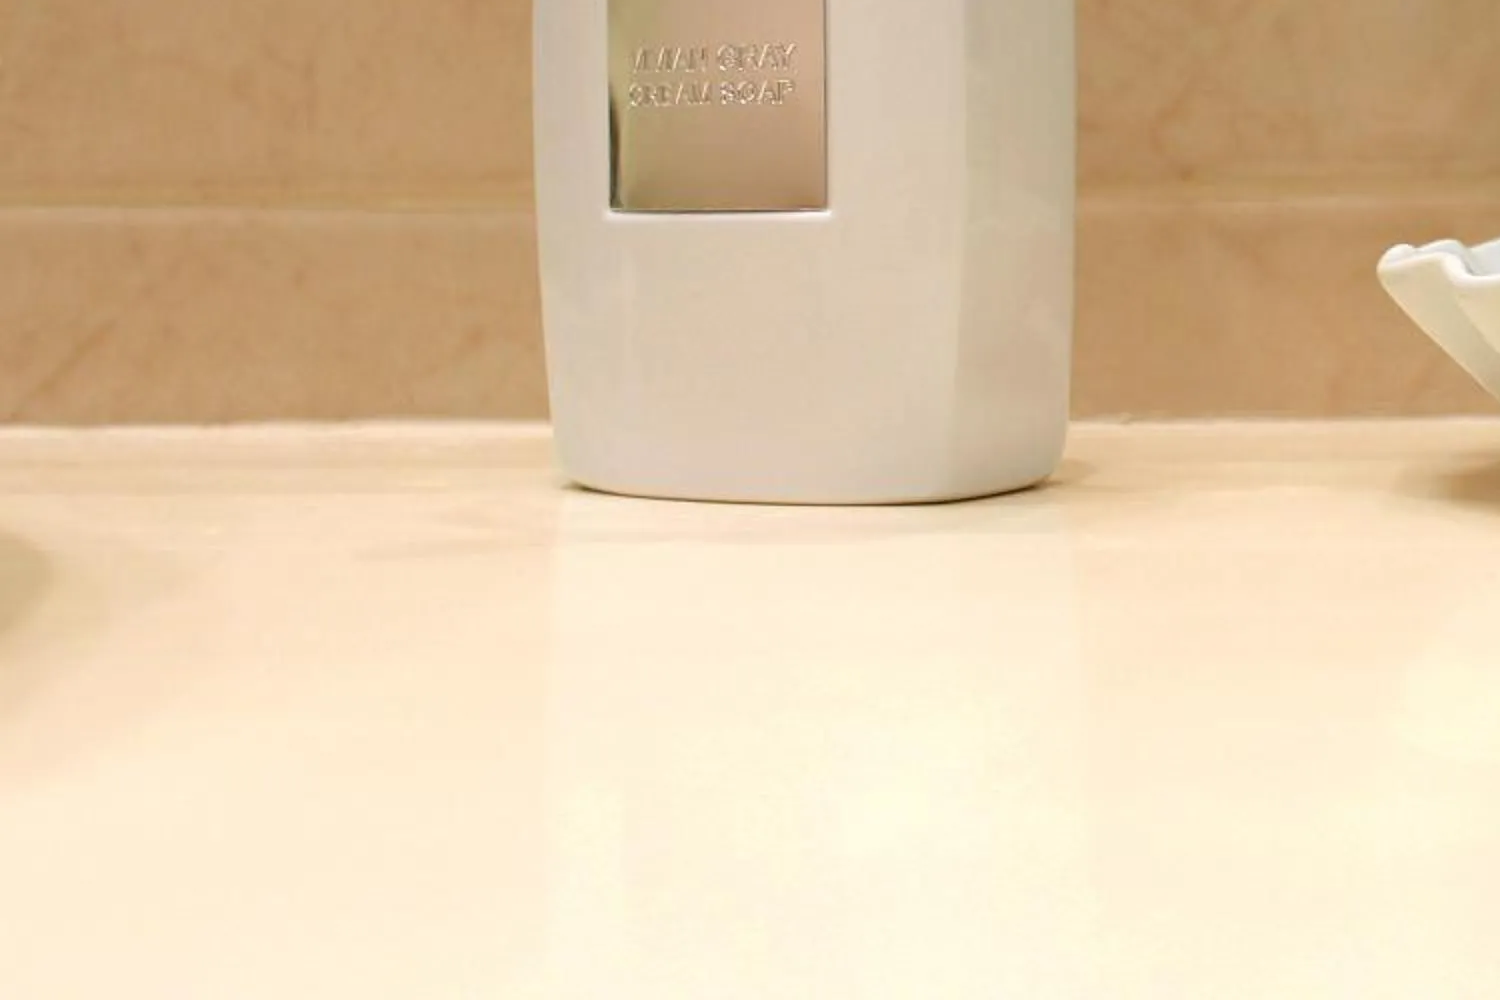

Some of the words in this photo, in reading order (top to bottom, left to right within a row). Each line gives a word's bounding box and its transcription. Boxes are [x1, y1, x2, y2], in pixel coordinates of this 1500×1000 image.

[717, 43, 797, 71] GRAY
[628, 81, 711, 106] CREAM
[719, 79, 794, 104] SOAP
